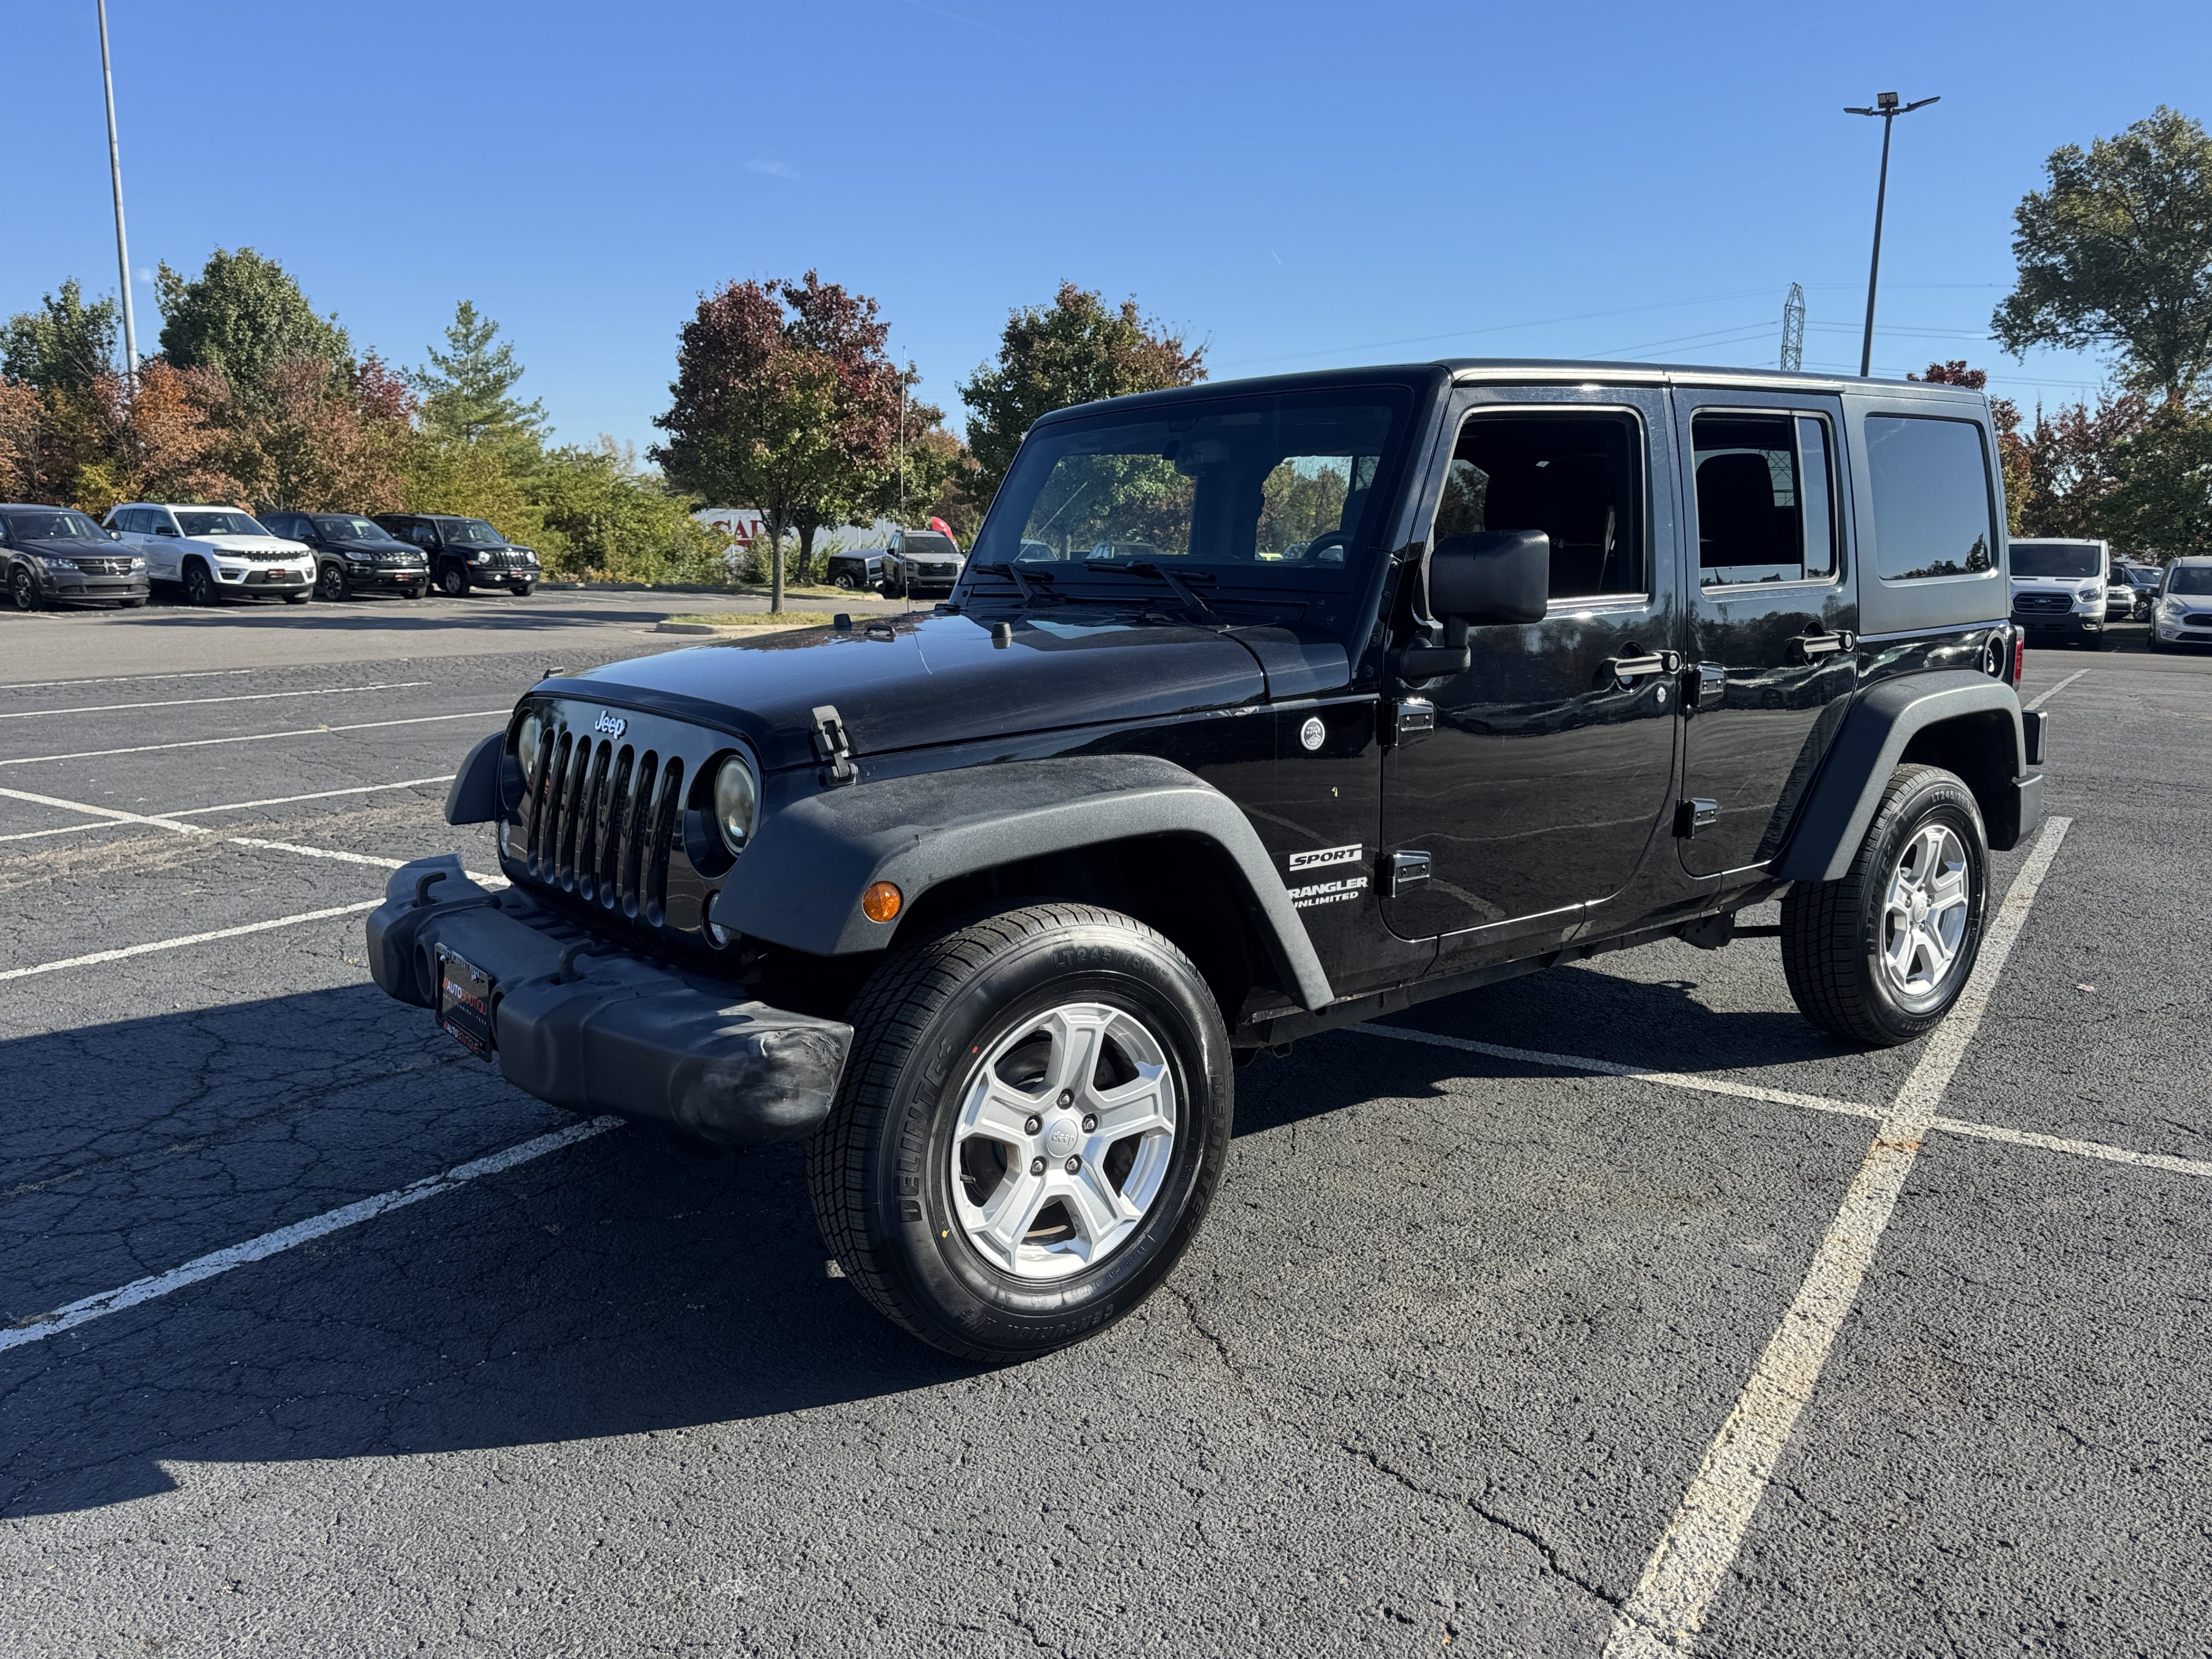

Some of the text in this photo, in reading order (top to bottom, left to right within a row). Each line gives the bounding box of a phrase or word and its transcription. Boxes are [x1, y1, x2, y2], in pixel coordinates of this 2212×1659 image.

[595, 710, 625, 740] Jeep
[1294, 849, 1361, 866] SPORT
[1286, 877, 1368, 899] RANGLER
[1052, 947, 1170, 985] LT245/75R17
[896, 1058, 947, 1223] DELINTE
[1051, 1131, 1075, 1146] Jeep
